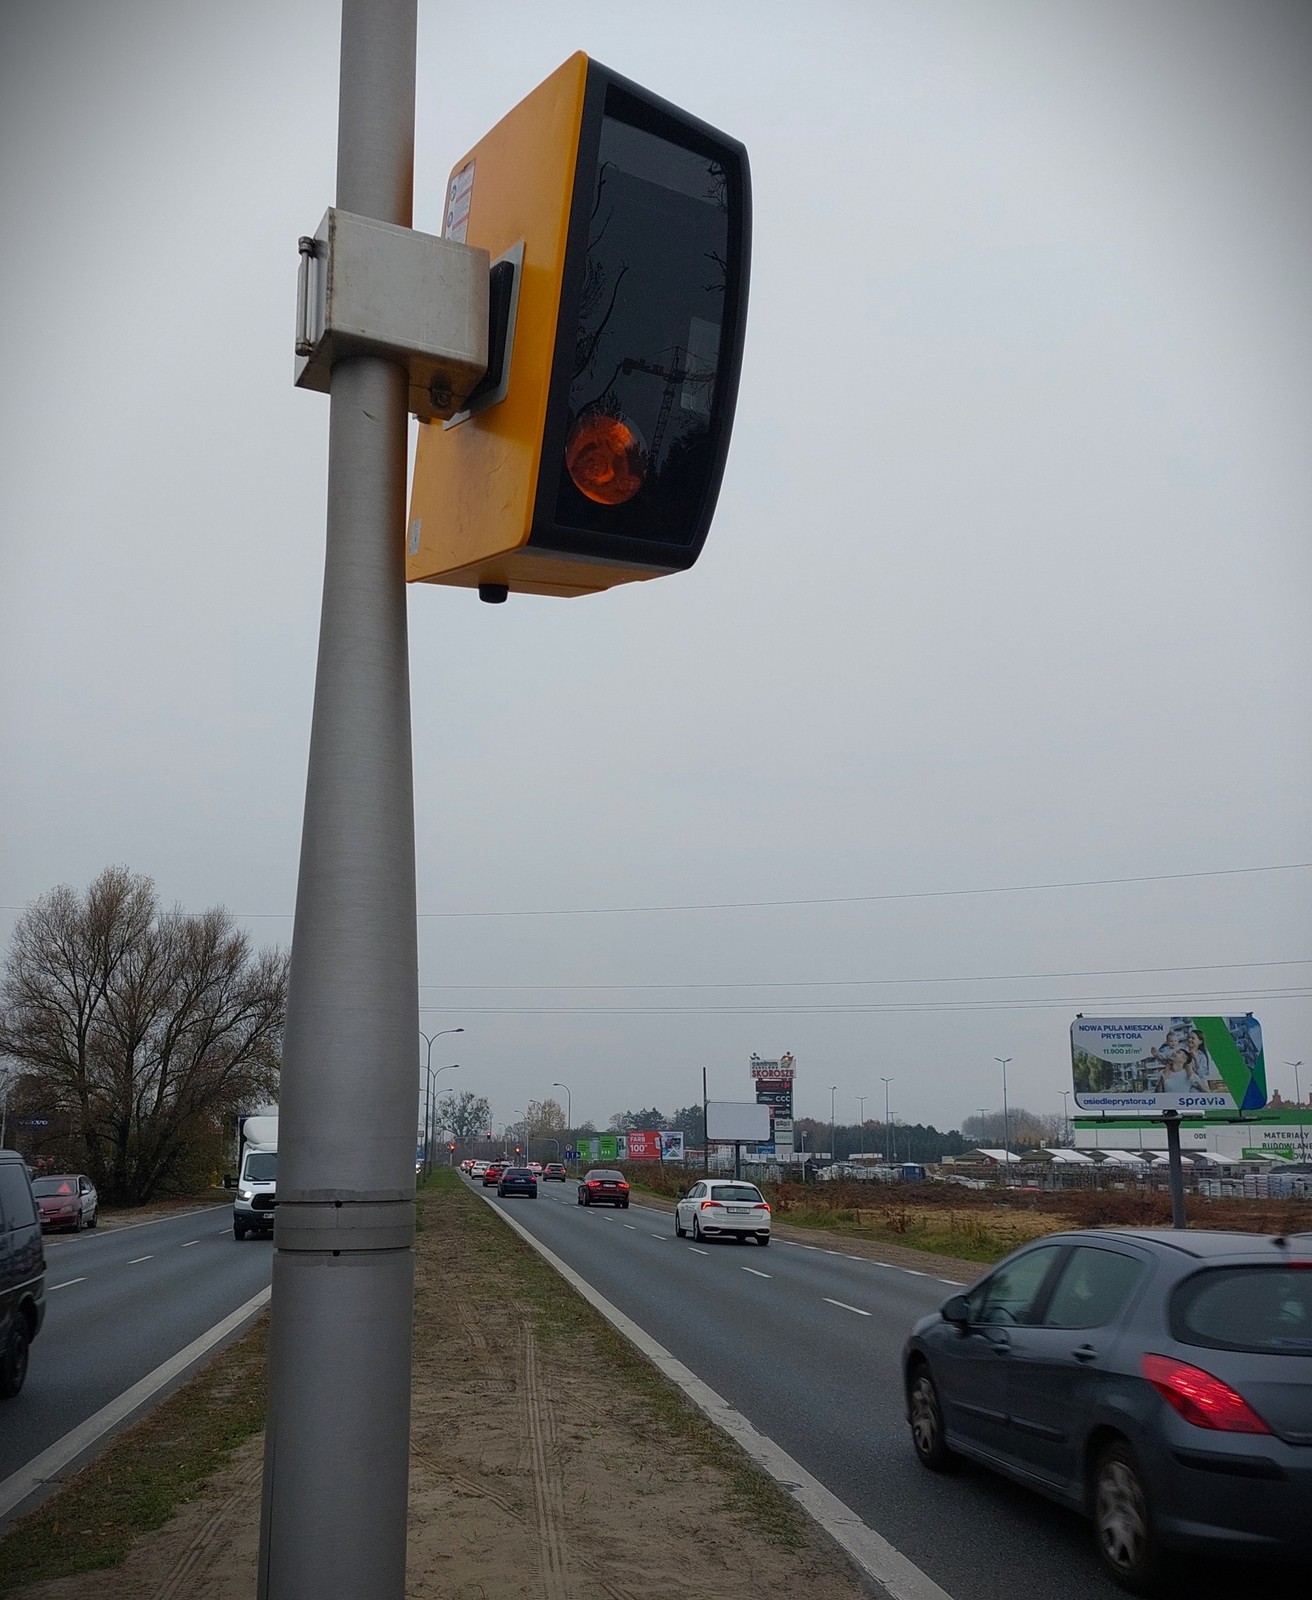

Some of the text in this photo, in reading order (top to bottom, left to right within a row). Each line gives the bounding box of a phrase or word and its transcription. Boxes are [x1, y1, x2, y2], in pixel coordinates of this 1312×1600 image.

[1124, 1023, 1164, 1031] MIESZKAŃ
[752, 1070, 794, 1078] SKOROSZE
[1083, 1097, 1156, 1106] osiedleprystora.pl
[1178, 1096, 1226, 1107] spravia
